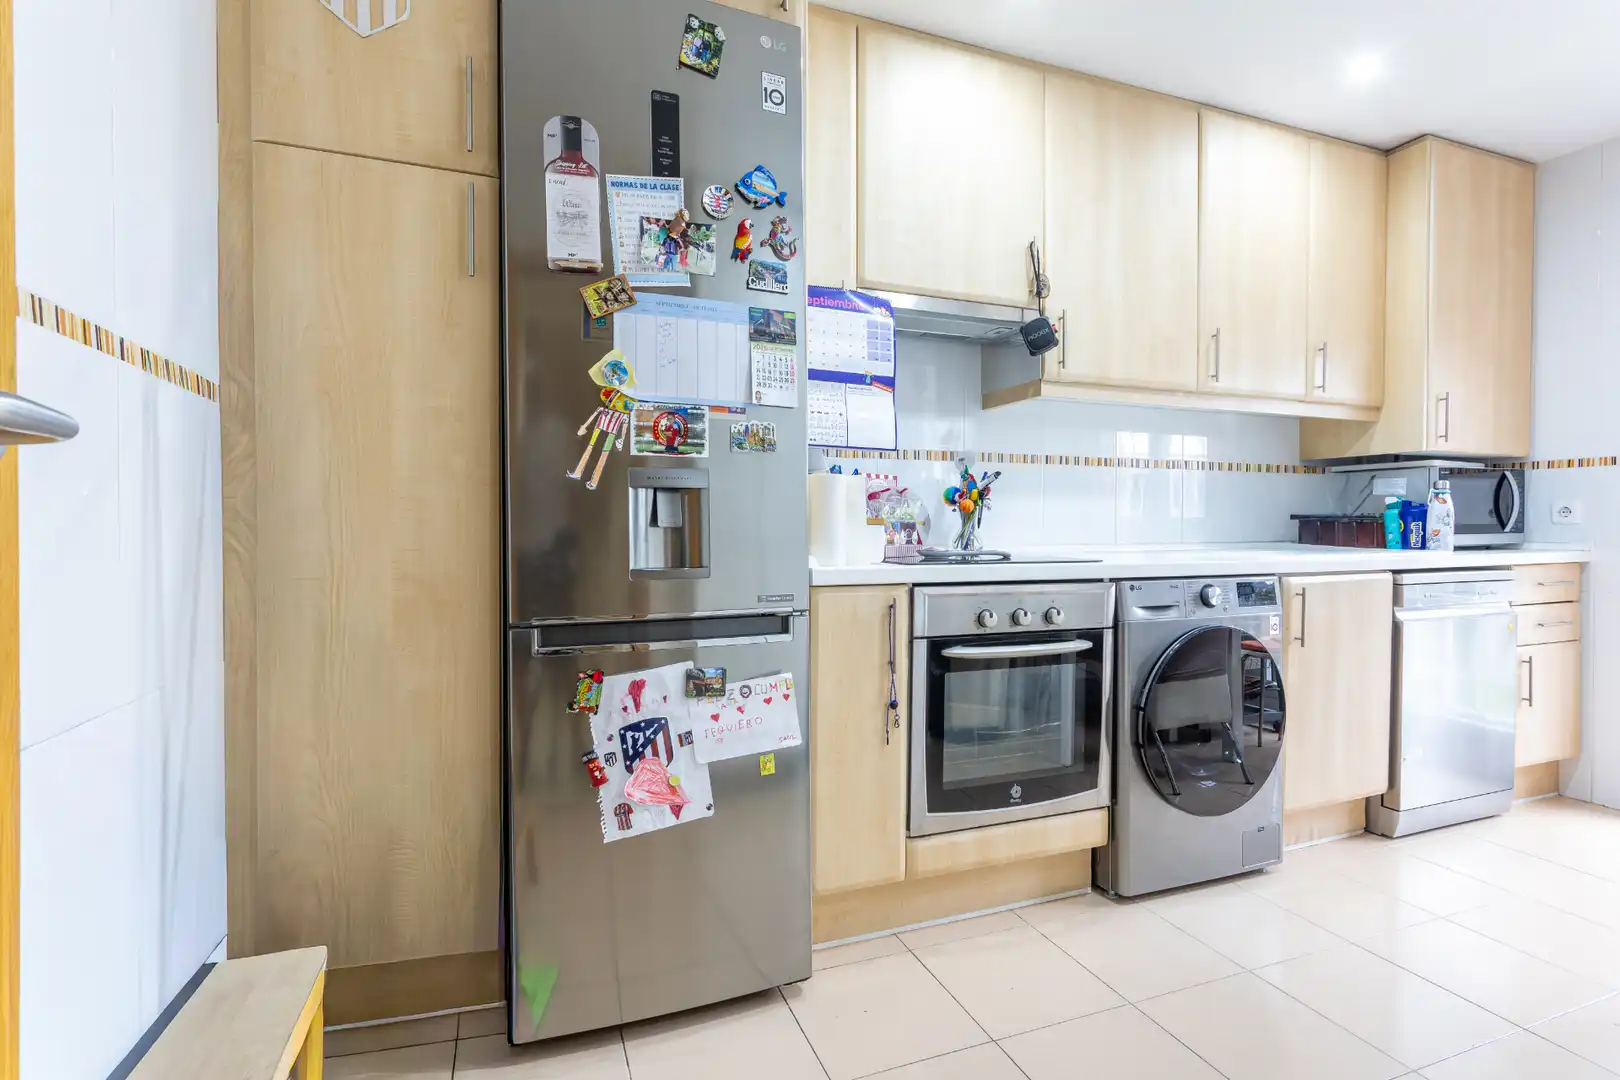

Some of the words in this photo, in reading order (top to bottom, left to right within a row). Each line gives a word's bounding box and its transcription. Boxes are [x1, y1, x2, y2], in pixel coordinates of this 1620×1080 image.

[773, 38, 787, 53] LG
[763, 86, 785, 107] 10
[610, 180, 638, 189] NORMAS
[640, 182, 648, 190] DE
[649, 183, 658, 191] LA
[659, 183, 680, 192] CLASE
[1410, 520, 1424, 548] Nesquik
